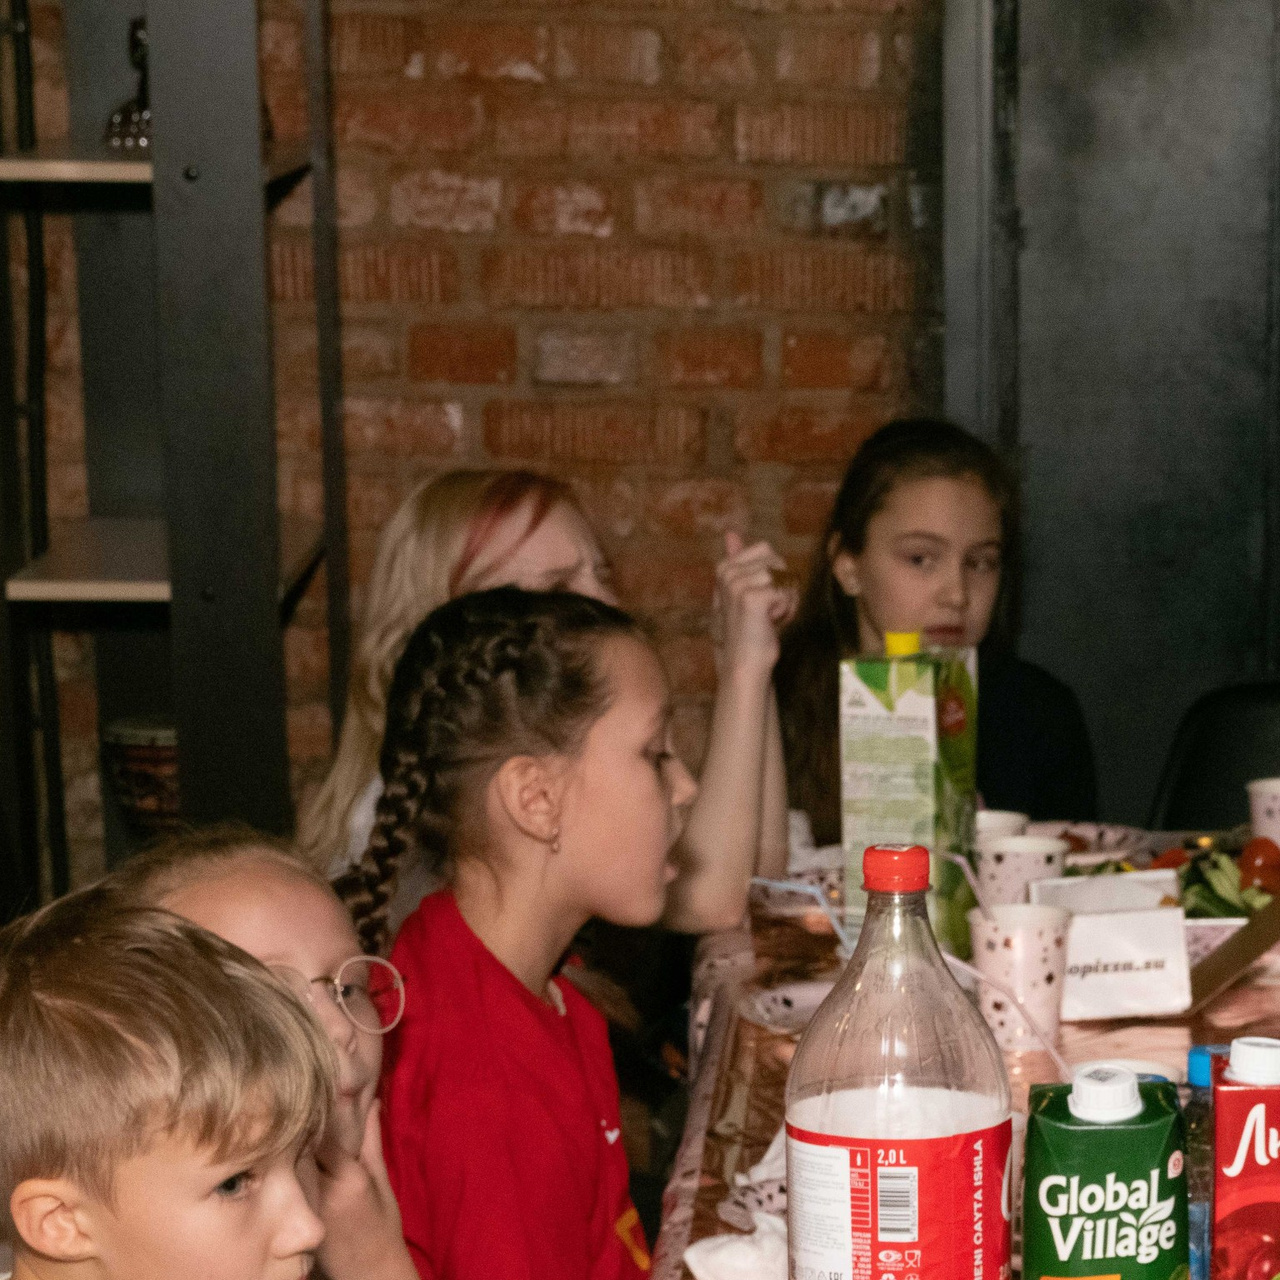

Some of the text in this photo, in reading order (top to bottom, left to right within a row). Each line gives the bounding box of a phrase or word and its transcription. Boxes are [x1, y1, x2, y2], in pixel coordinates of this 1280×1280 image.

[899, 1150, 907, 1164] L
[973, 1139, 983, 1187] ISHLA
[1038, 1169, 1173, 1216] Global
[1047, 1215, 1176, 1264] Village
